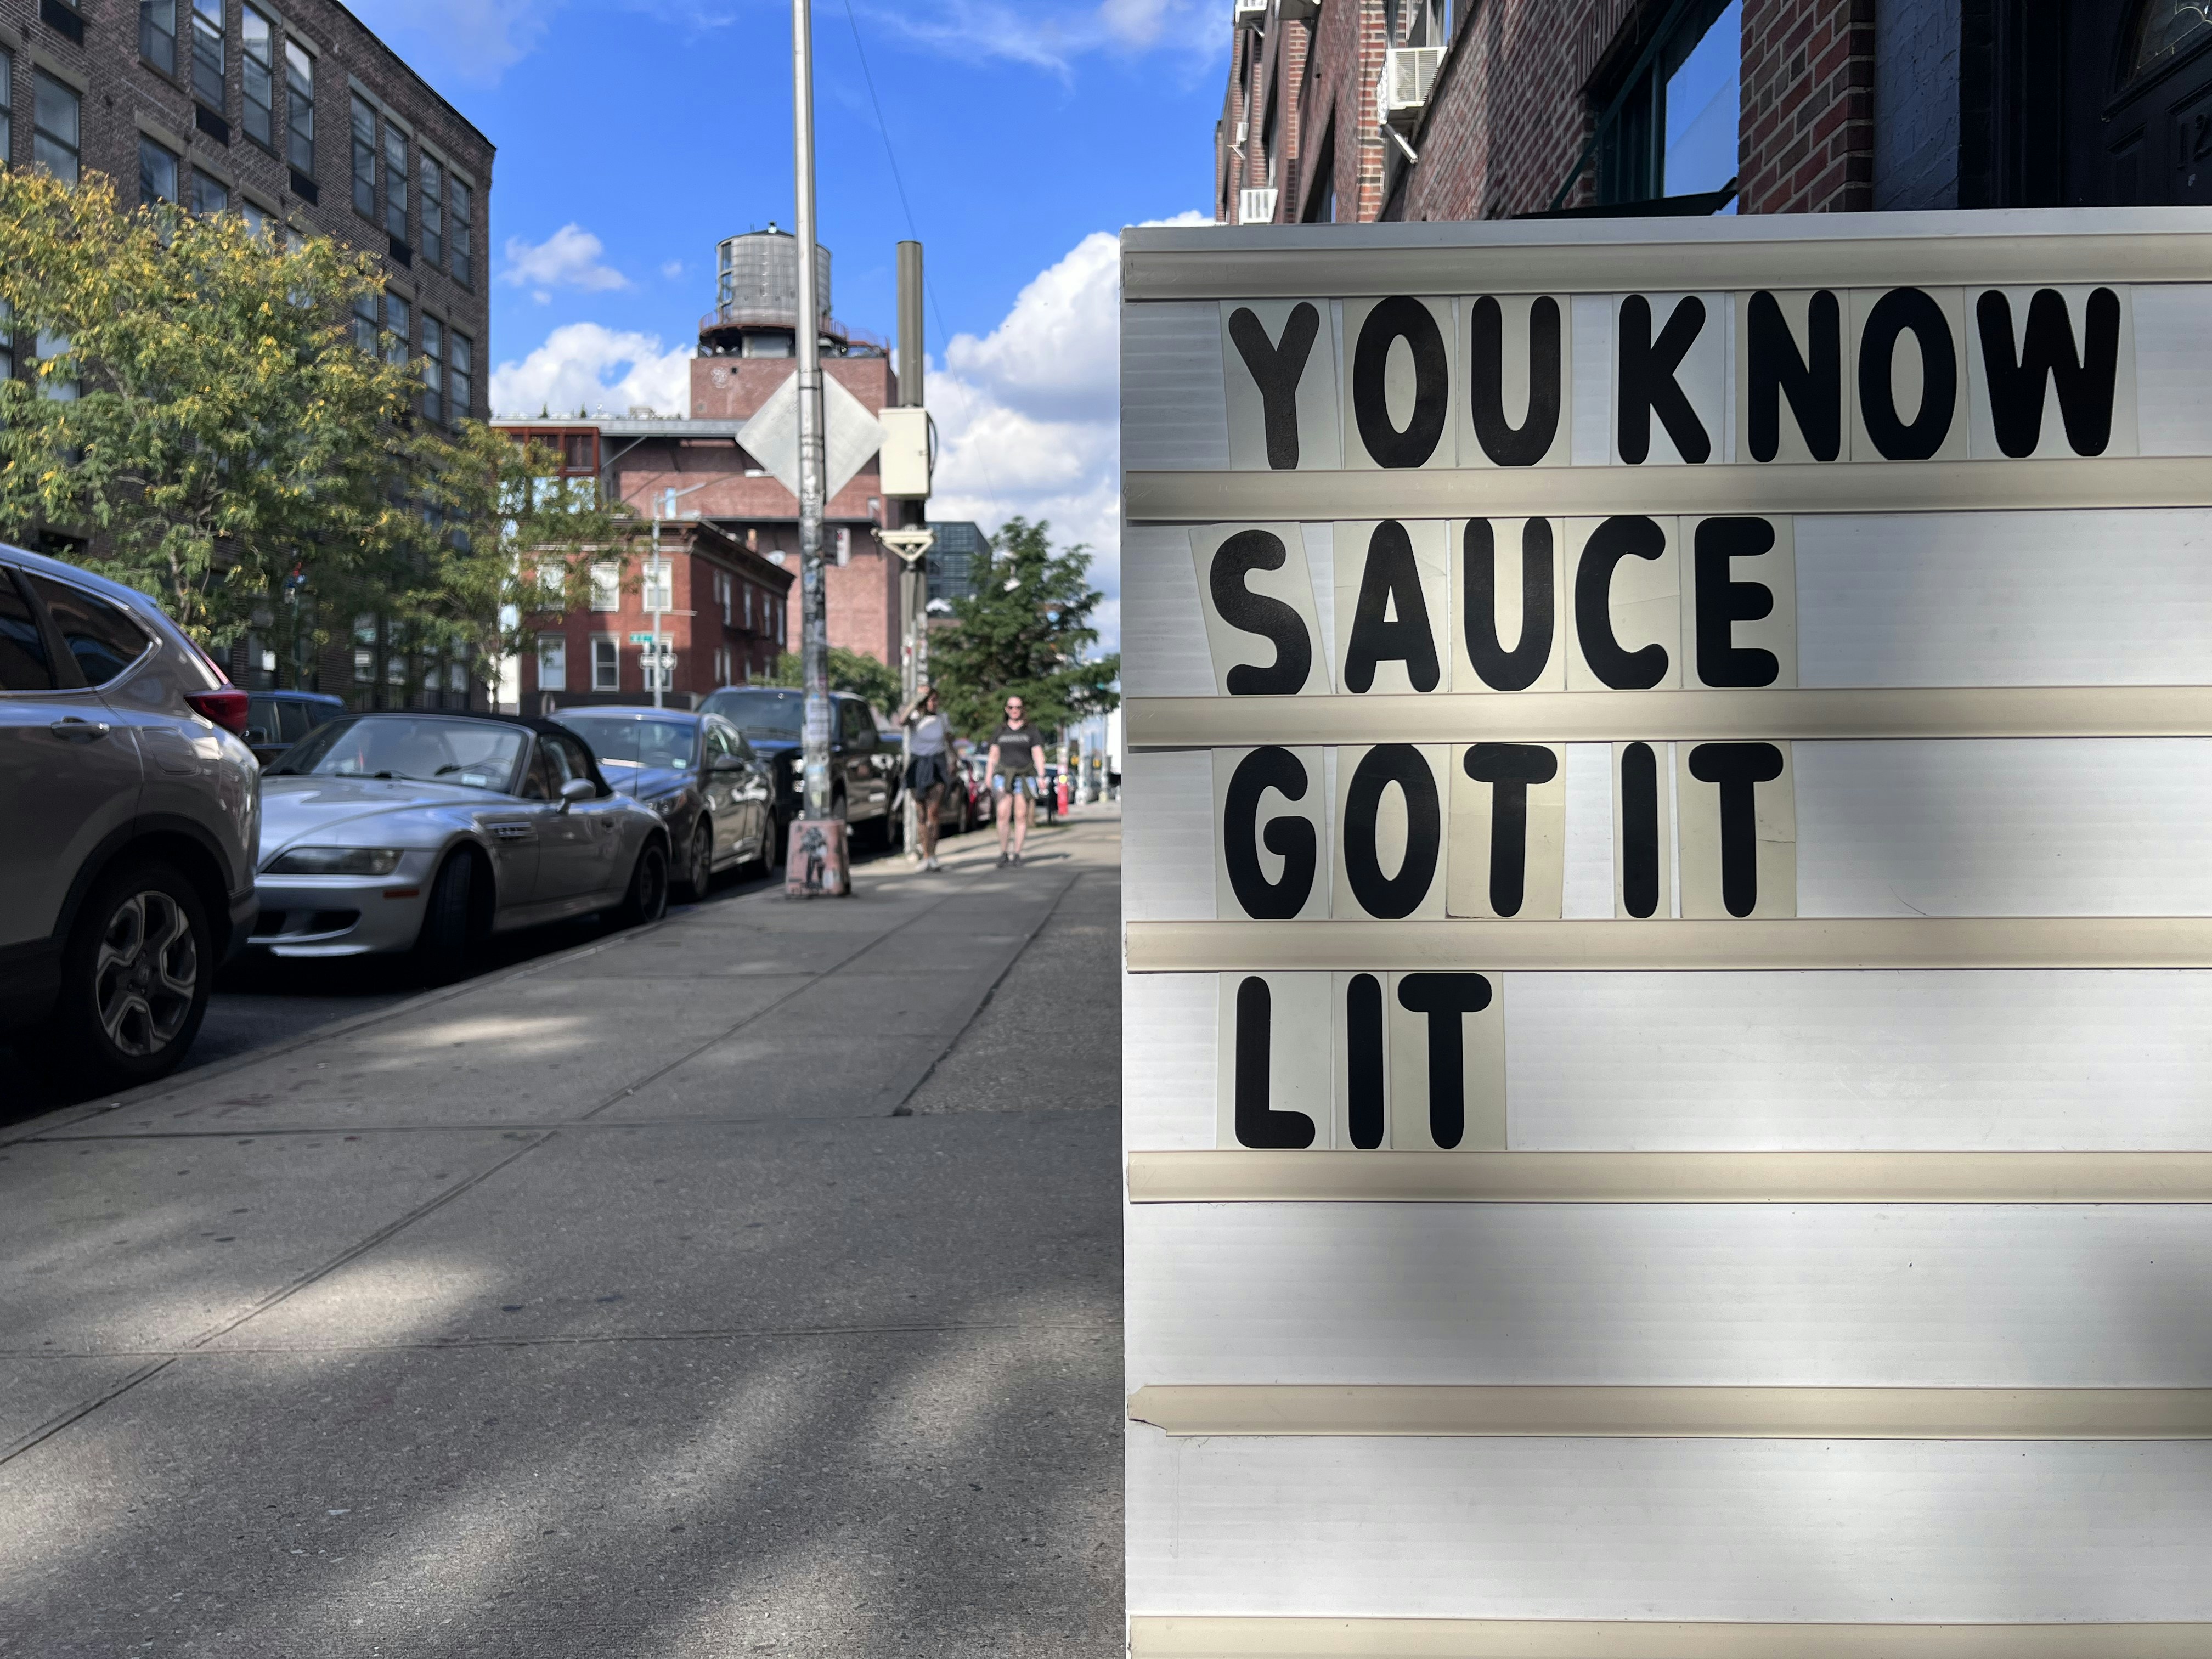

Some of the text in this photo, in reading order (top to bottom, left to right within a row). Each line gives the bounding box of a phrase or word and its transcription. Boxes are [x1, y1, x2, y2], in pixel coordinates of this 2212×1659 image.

[1229, 287, 2120, 470] YOU KNOW
[1210, 516, 1779, 695] SAUCE
[1224, 742, 1783, 919] GOT IT
[1235, 973, 1492, 1149] LIT
